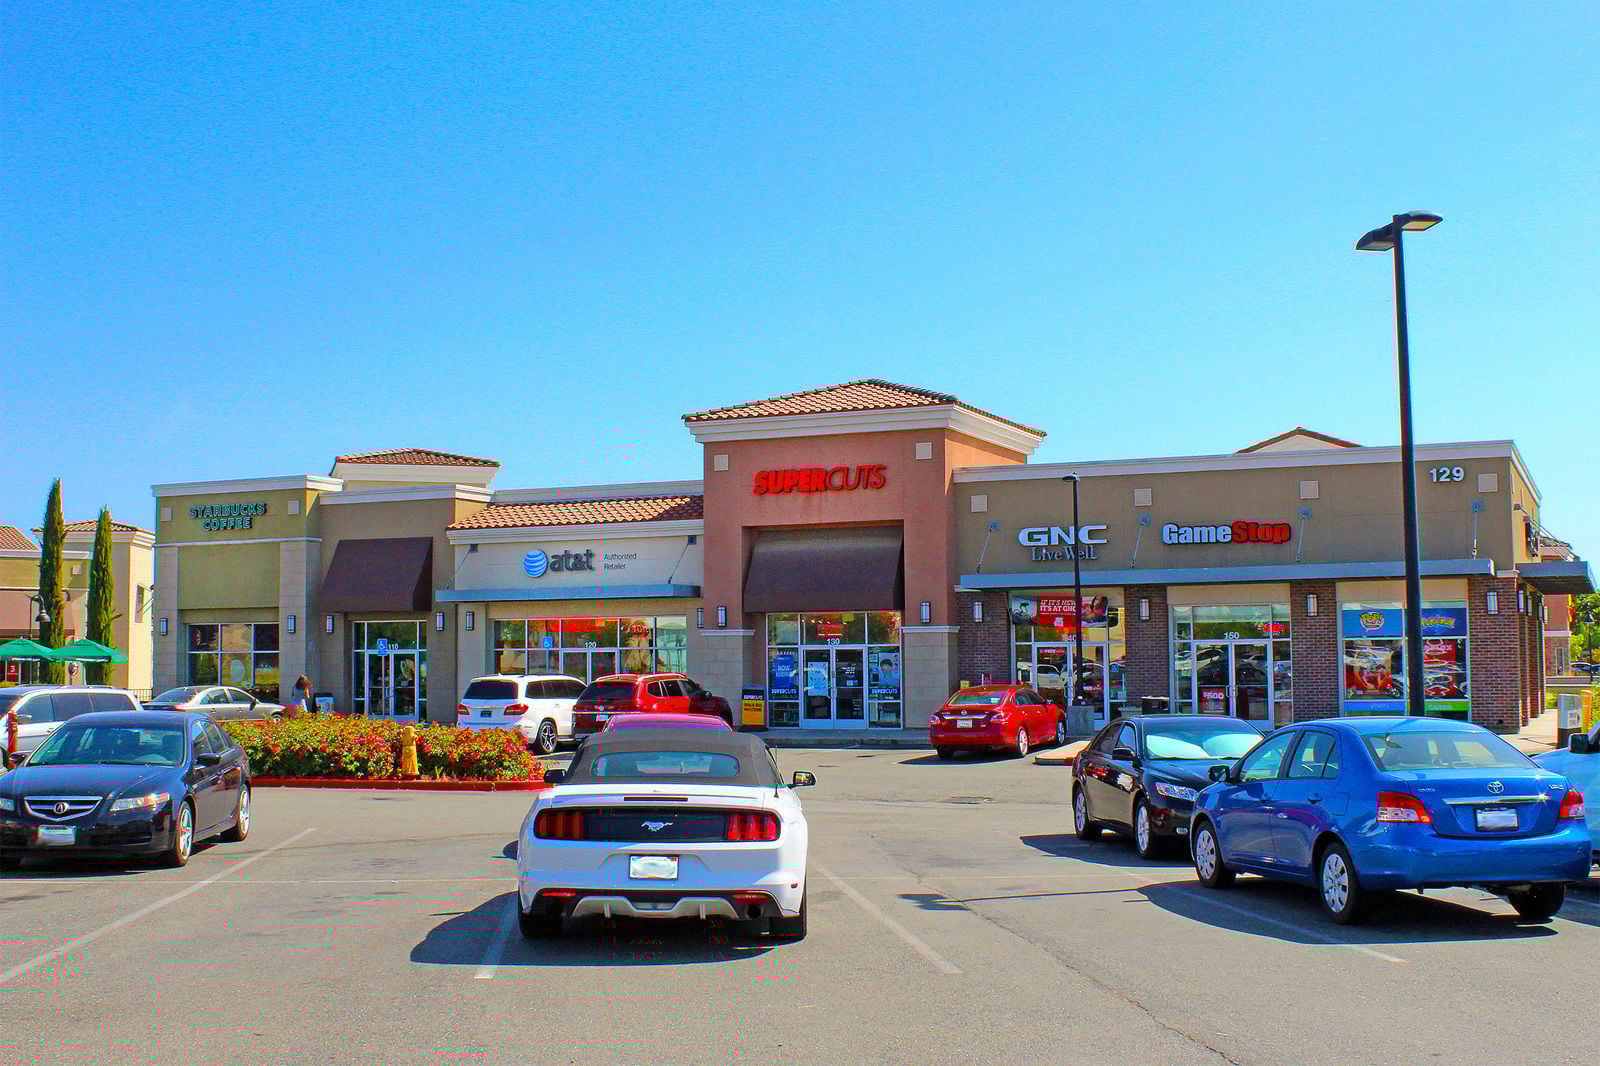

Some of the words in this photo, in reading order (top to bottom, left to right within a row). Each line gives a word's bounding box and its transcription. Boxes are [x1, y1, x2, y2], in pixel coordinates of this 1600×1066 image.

[753, 464, 887, 495] SUPERCUTS
[1429, 466, 1465, 483] 129
[189, 502, 267, 518] STARBUCKS
[203, 517, 252, 531] COFFEE
[1018, 524, 1107, 546] GNC
[1161, 521, 1291, 545] GameStop
[550, 549, 594, 572] at&t
[604, 552, 637, 561] Authorized
[826, 637, 840, 645] 130
[1223, 631, 1240, 640] 150
[584, 641, 597, 649] 120
